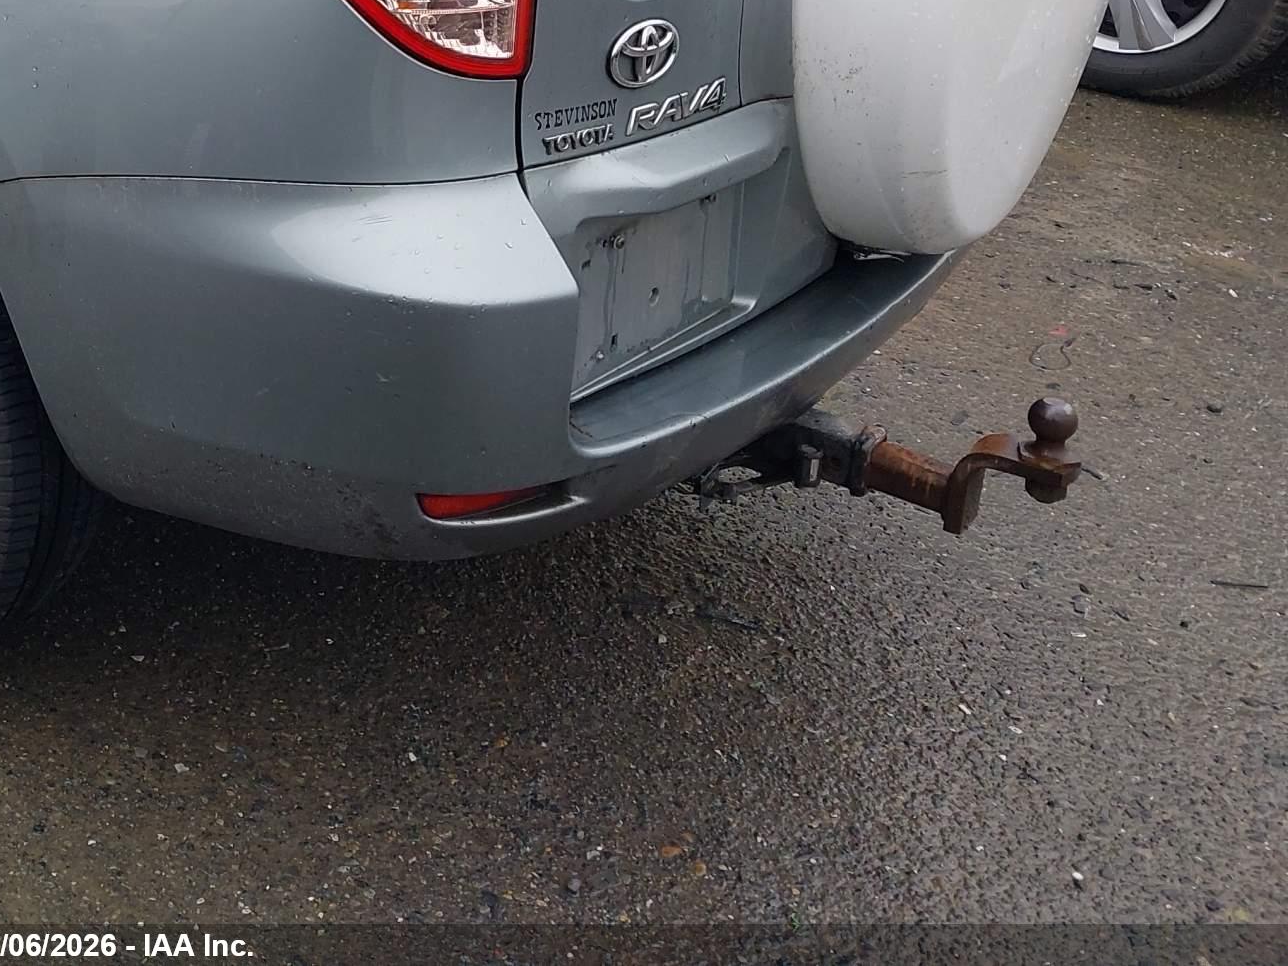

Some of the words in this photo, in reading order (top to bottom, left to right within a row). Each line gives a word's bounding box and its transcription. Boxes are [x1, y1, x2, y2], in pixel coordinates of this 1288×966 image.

[534, 98, 617, 130] STEVINSON
[626, 77, 727, 135] RAV4
[542, 123, 613, 155] TOYOTA
